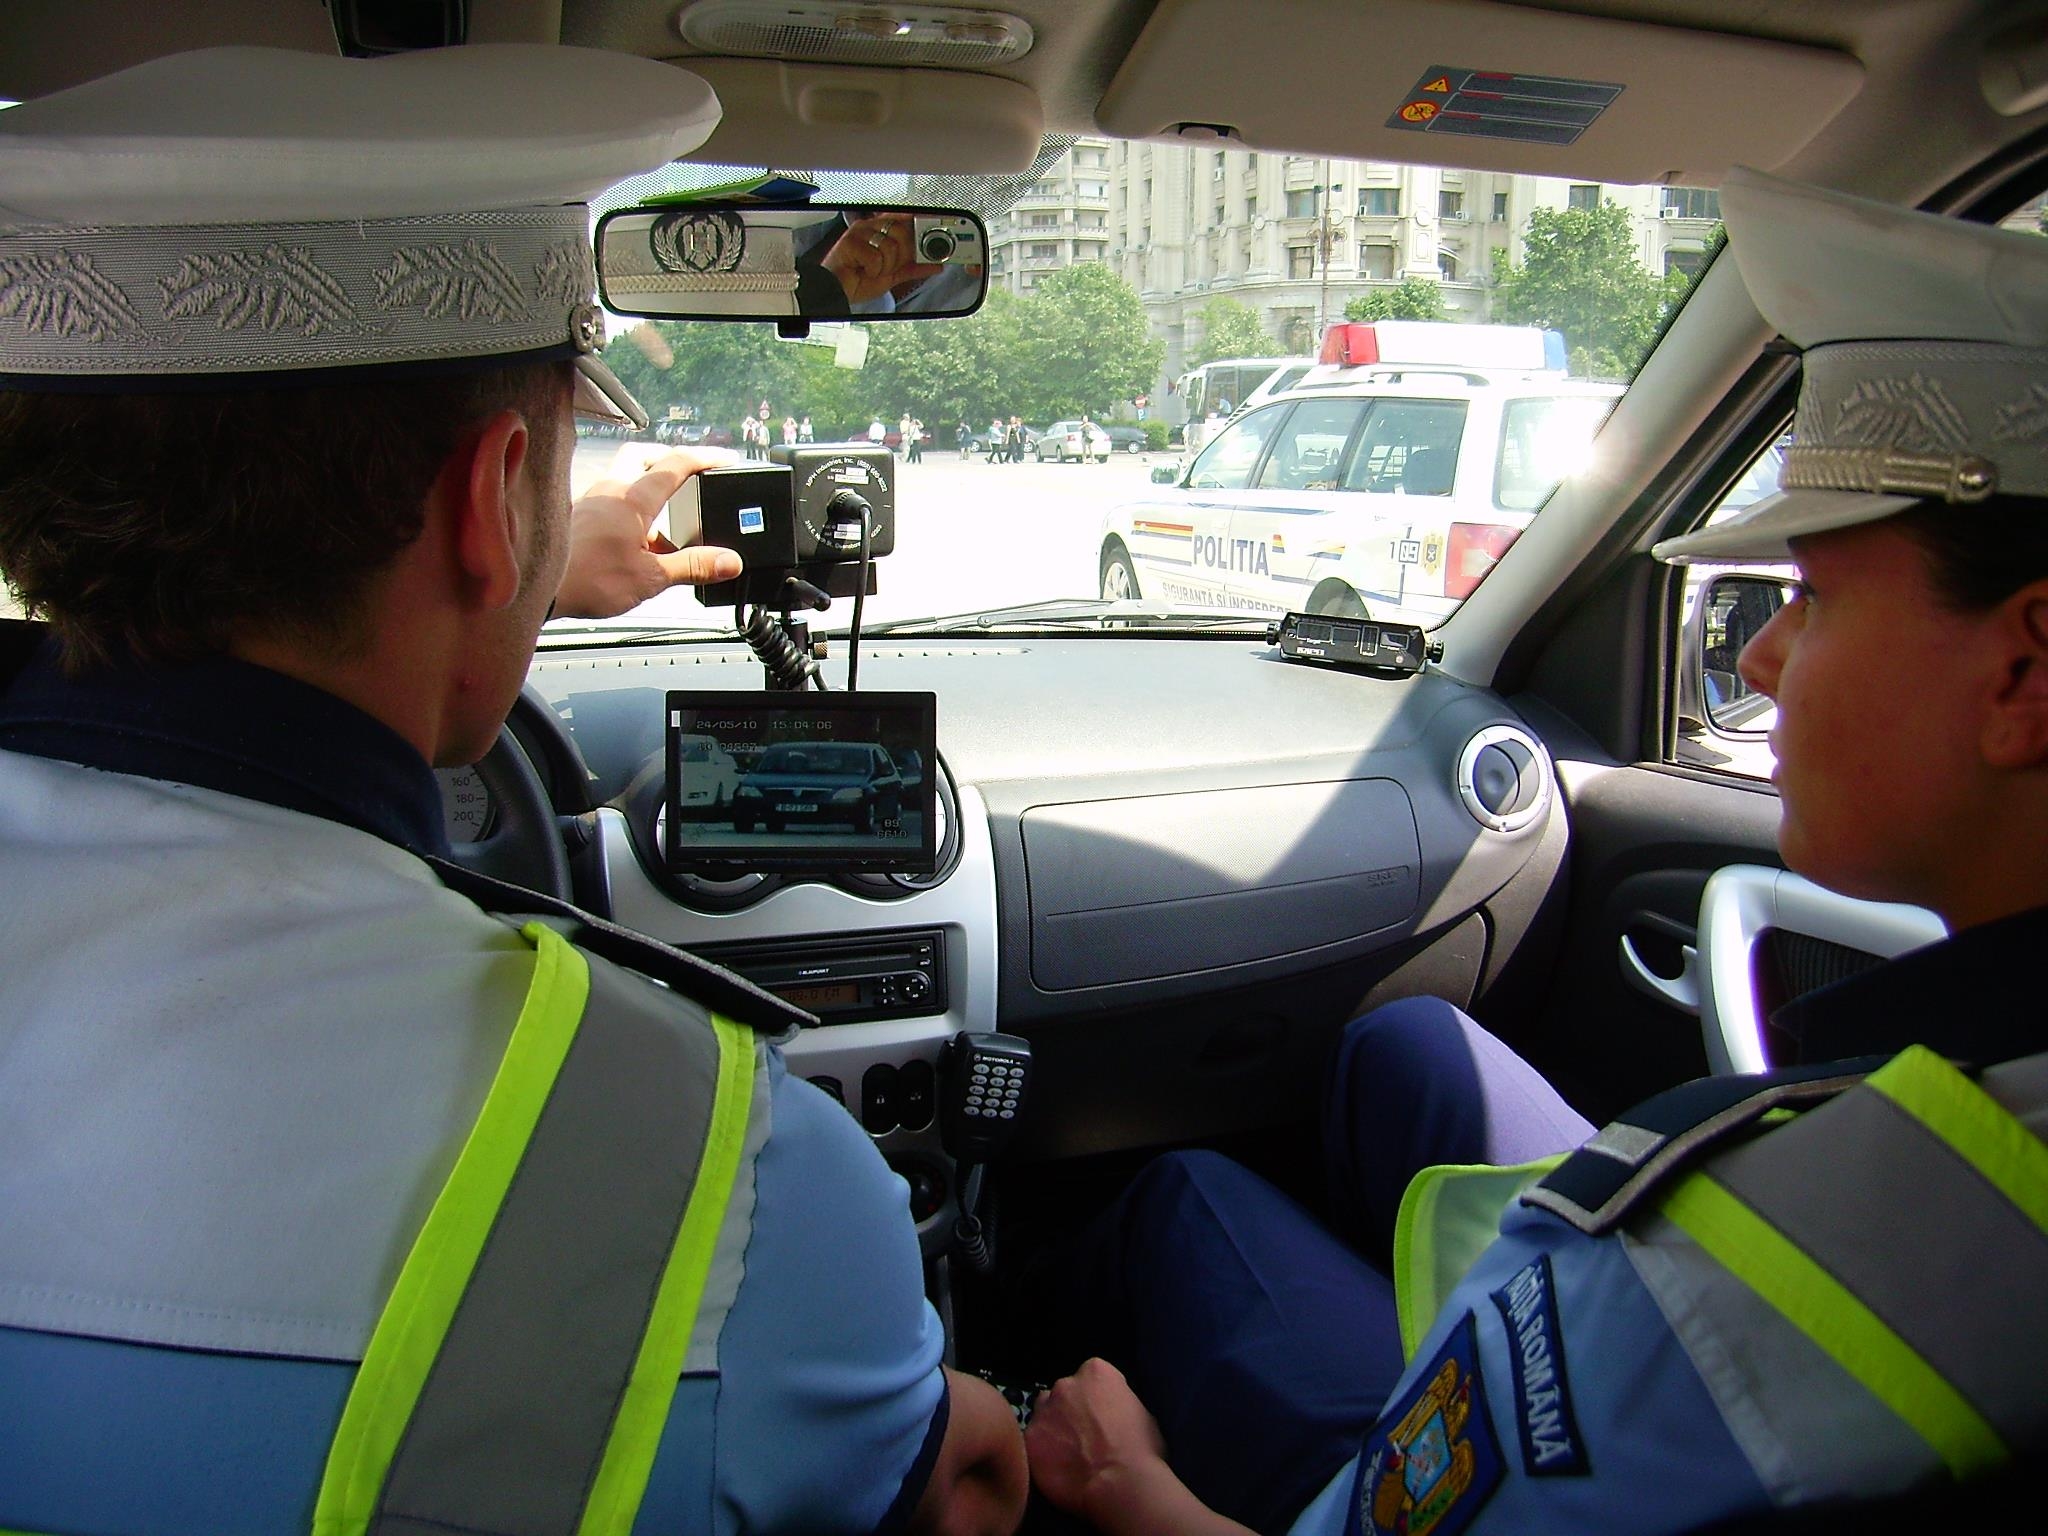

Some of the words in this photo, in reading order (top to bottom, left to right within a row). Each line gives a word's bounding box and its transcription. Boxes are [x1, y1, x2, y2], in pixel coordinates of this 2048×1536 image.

[696, 720, 757, 729] 24/05/10
[773, 720, 832, 730] 15:04:06
[454, 811, 474, 821] 200
[982, 1056, 1014, 1065] MOTOROLA
